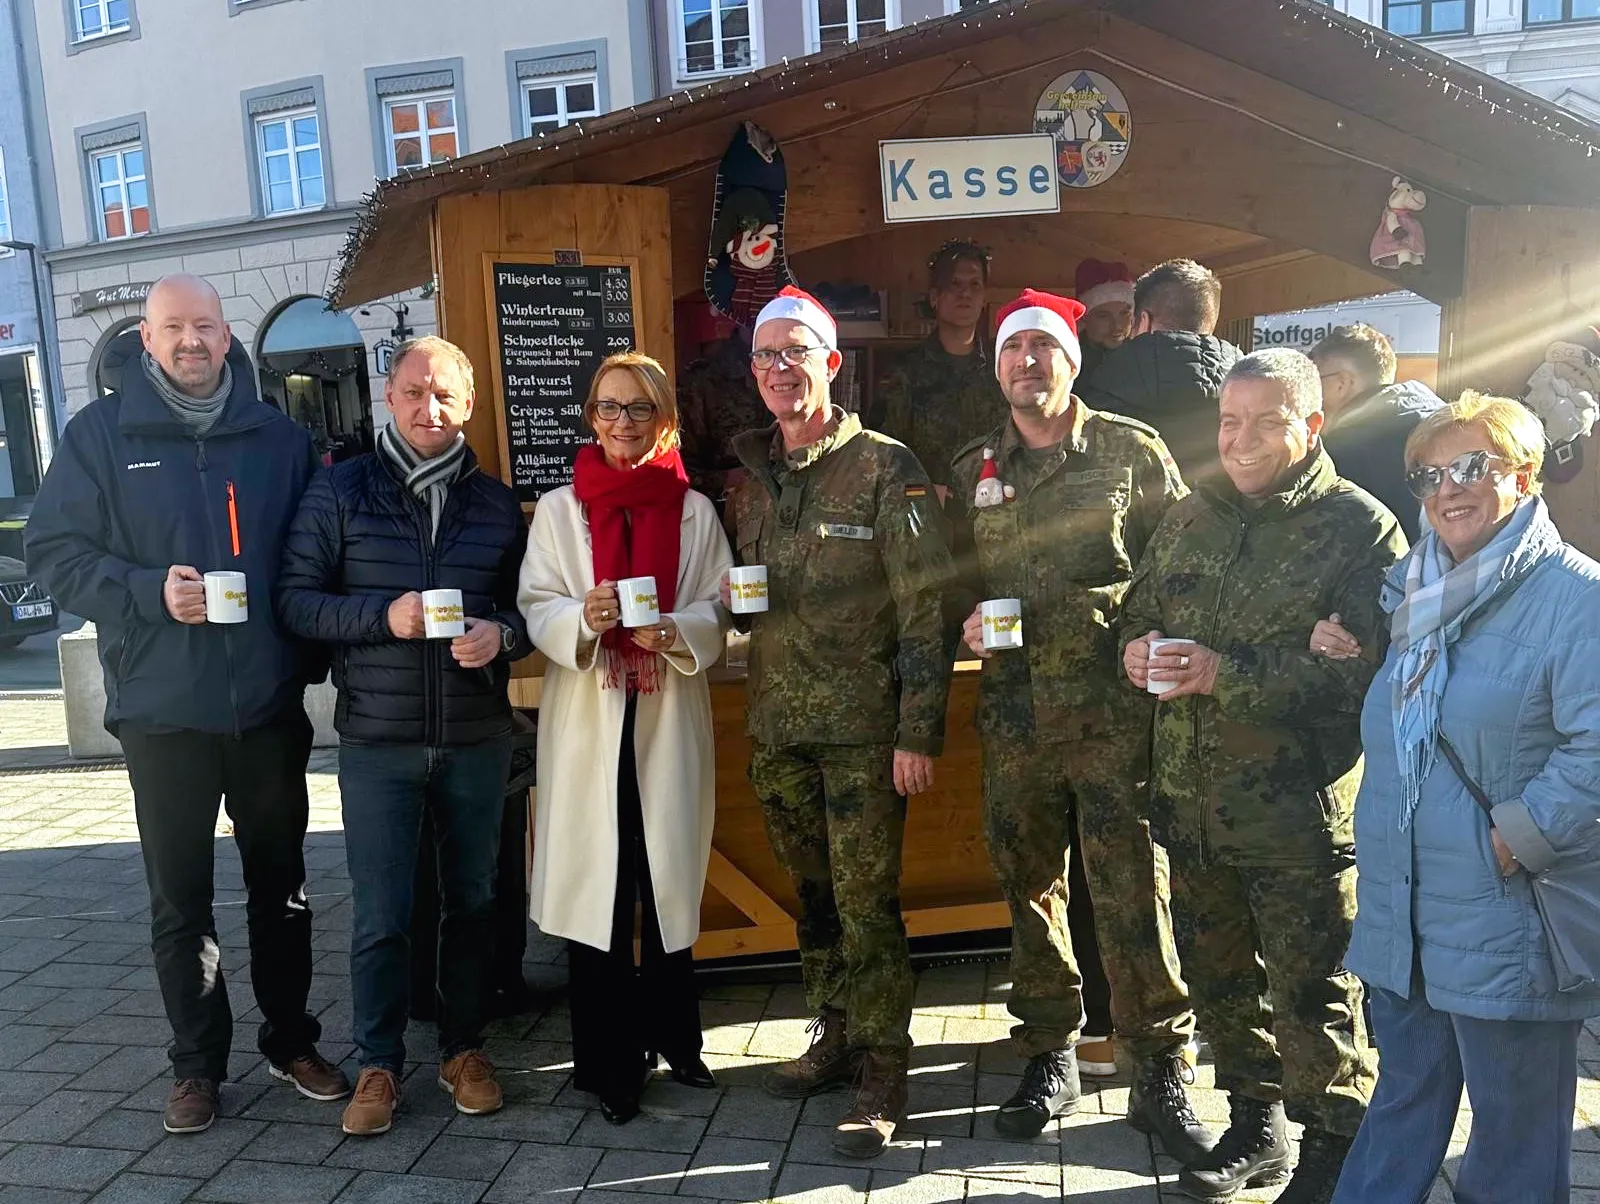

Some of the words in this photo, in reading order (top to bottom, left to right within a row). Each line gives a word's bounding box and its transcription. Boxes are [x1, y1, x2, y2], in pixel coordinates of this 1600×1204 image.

[889, 158, 1050, 203] Kasse
[498, 273, 562, 288] Fliegertee
[96, 290, 117, 304] Hut
[501, 304, 585, 317] Wintertraum
[502, 318, 560, 328] Kinderpunsch
[504, 334, 585, 348] Schneeflocke
[607, 337, 630, 347] 2,00
[505, 348, 552, 358] Eierpunsch
[555, 349, 569, 357] mit
[573, 349, 593, 357] Rum
[516, 358, 580, 367] Sahnehäubchen
[508, 374, 572, 386] Bratwurst
[509, 388, 517, 397] in
[521, 388, 536, 396] der
[539, 388, 573, 397] Semmel
[510, 404, 555, 419] Crèpes
[560, 404, 582, 417] süß
[511, 419, 526, 427] mit
[530, 419, 559, 427] Nutella
[512, 428, 527, 436] mit
[530, 428, 576, 436] Marmelade
[513, 438, 528, 446] mit
[531, 437, 560, 445] Zucker
[574, 436, 594, 445] Zimt
[128, 460, 161, 470] MAMMUT
[515, 454, 567, 468] Allgäuer
[515, 468, 546, 477] Crèpes
[562, 466, 575, 475] Kä
[516, 477, 532, 485] und
